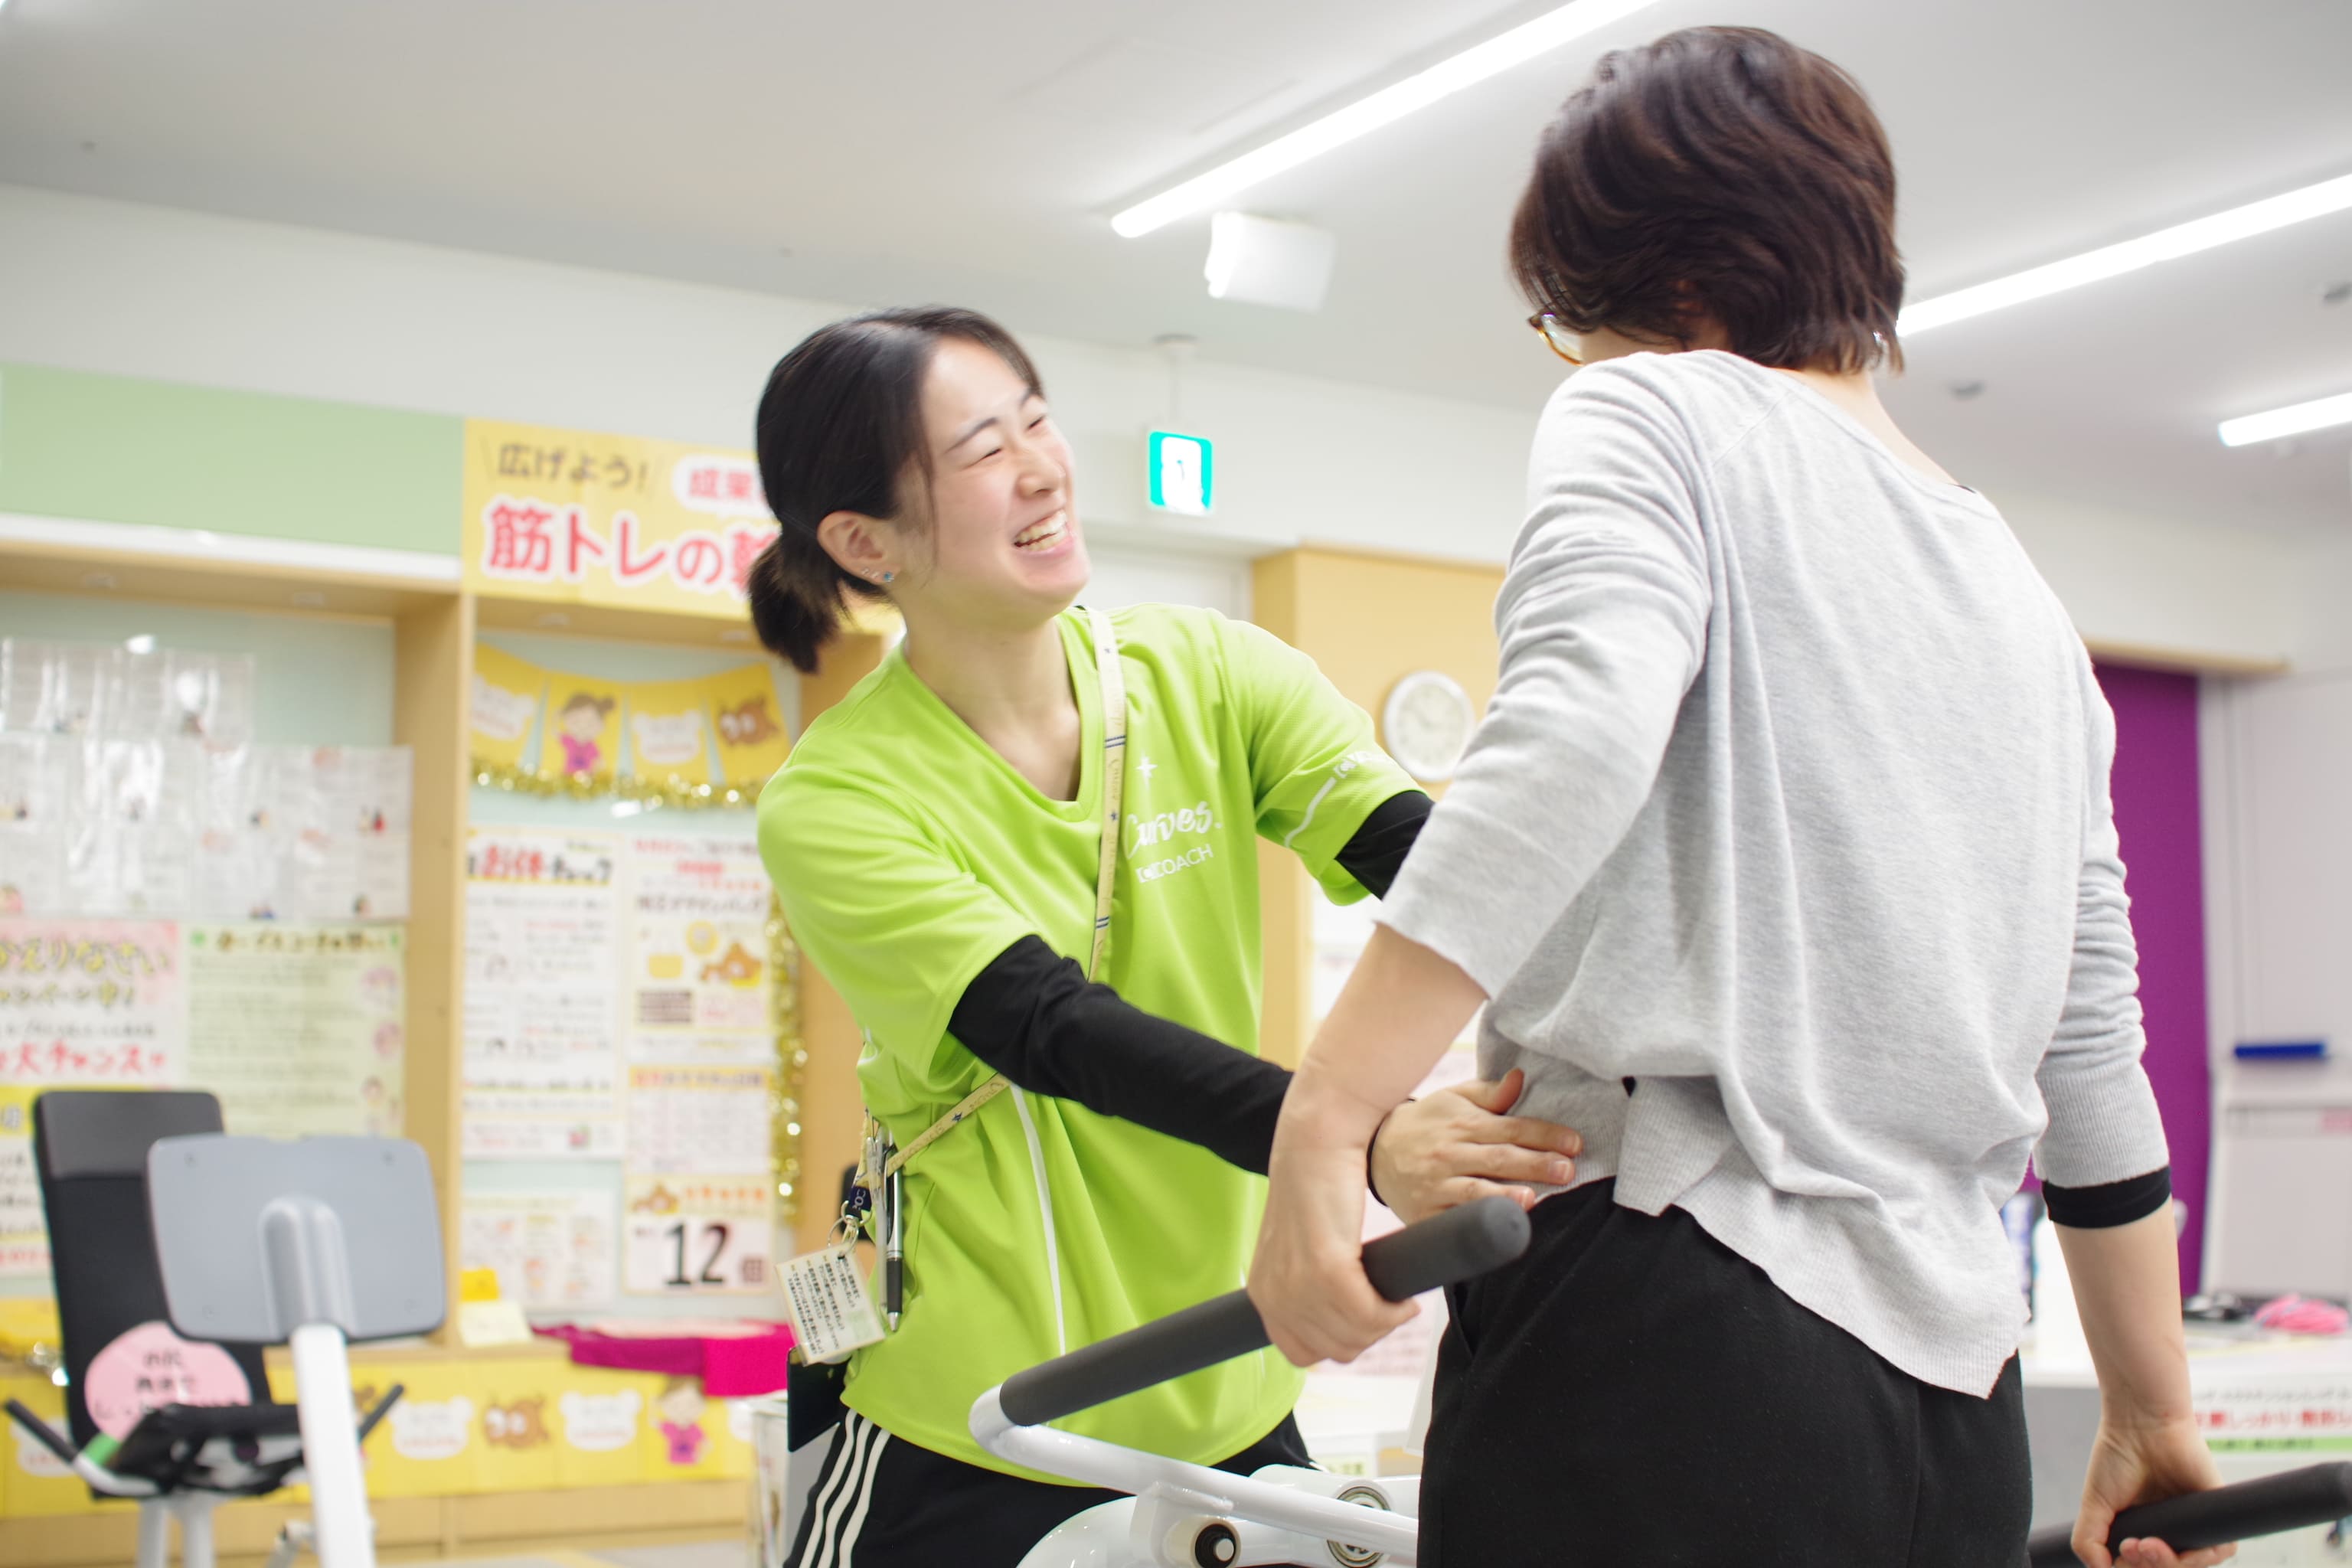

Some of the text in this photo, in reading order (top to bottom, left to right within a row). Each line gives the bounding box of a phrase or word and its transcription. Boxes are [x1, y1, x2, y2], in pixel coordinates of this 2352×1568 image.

[498, 443, 648, 492] 広げよう！
[688, 467, 767, 502] 成果
